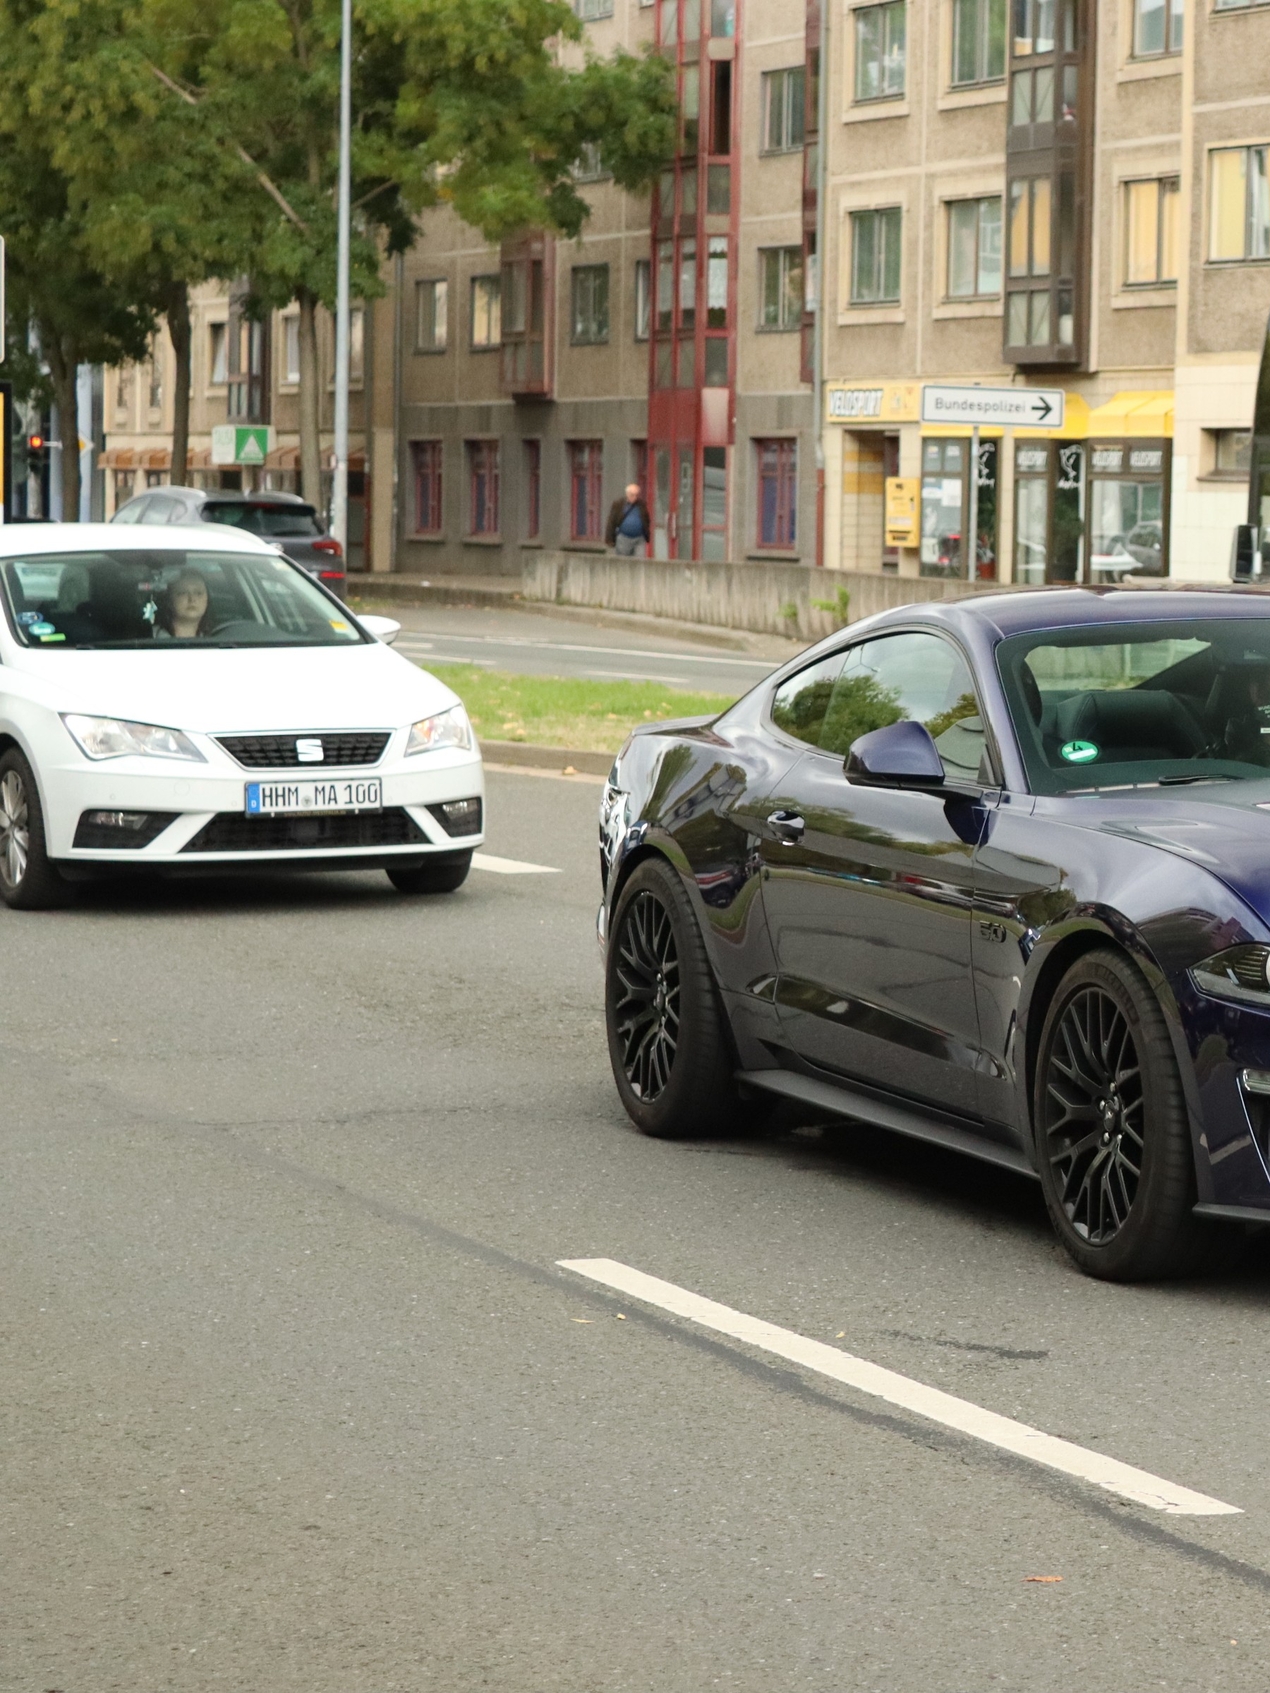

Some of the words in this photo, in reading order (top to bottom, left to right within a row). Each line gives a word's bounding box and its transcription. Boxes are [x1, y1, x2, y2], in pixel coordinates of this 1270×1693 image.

[829, 388, 884, 417] VELOSPORT
[934, 397, 1026, 415] Bundespolizei
[262, 786, 298, 807] HHM
[315, 784, 338, 805] MA
[344, 783, 378, 804] 100
